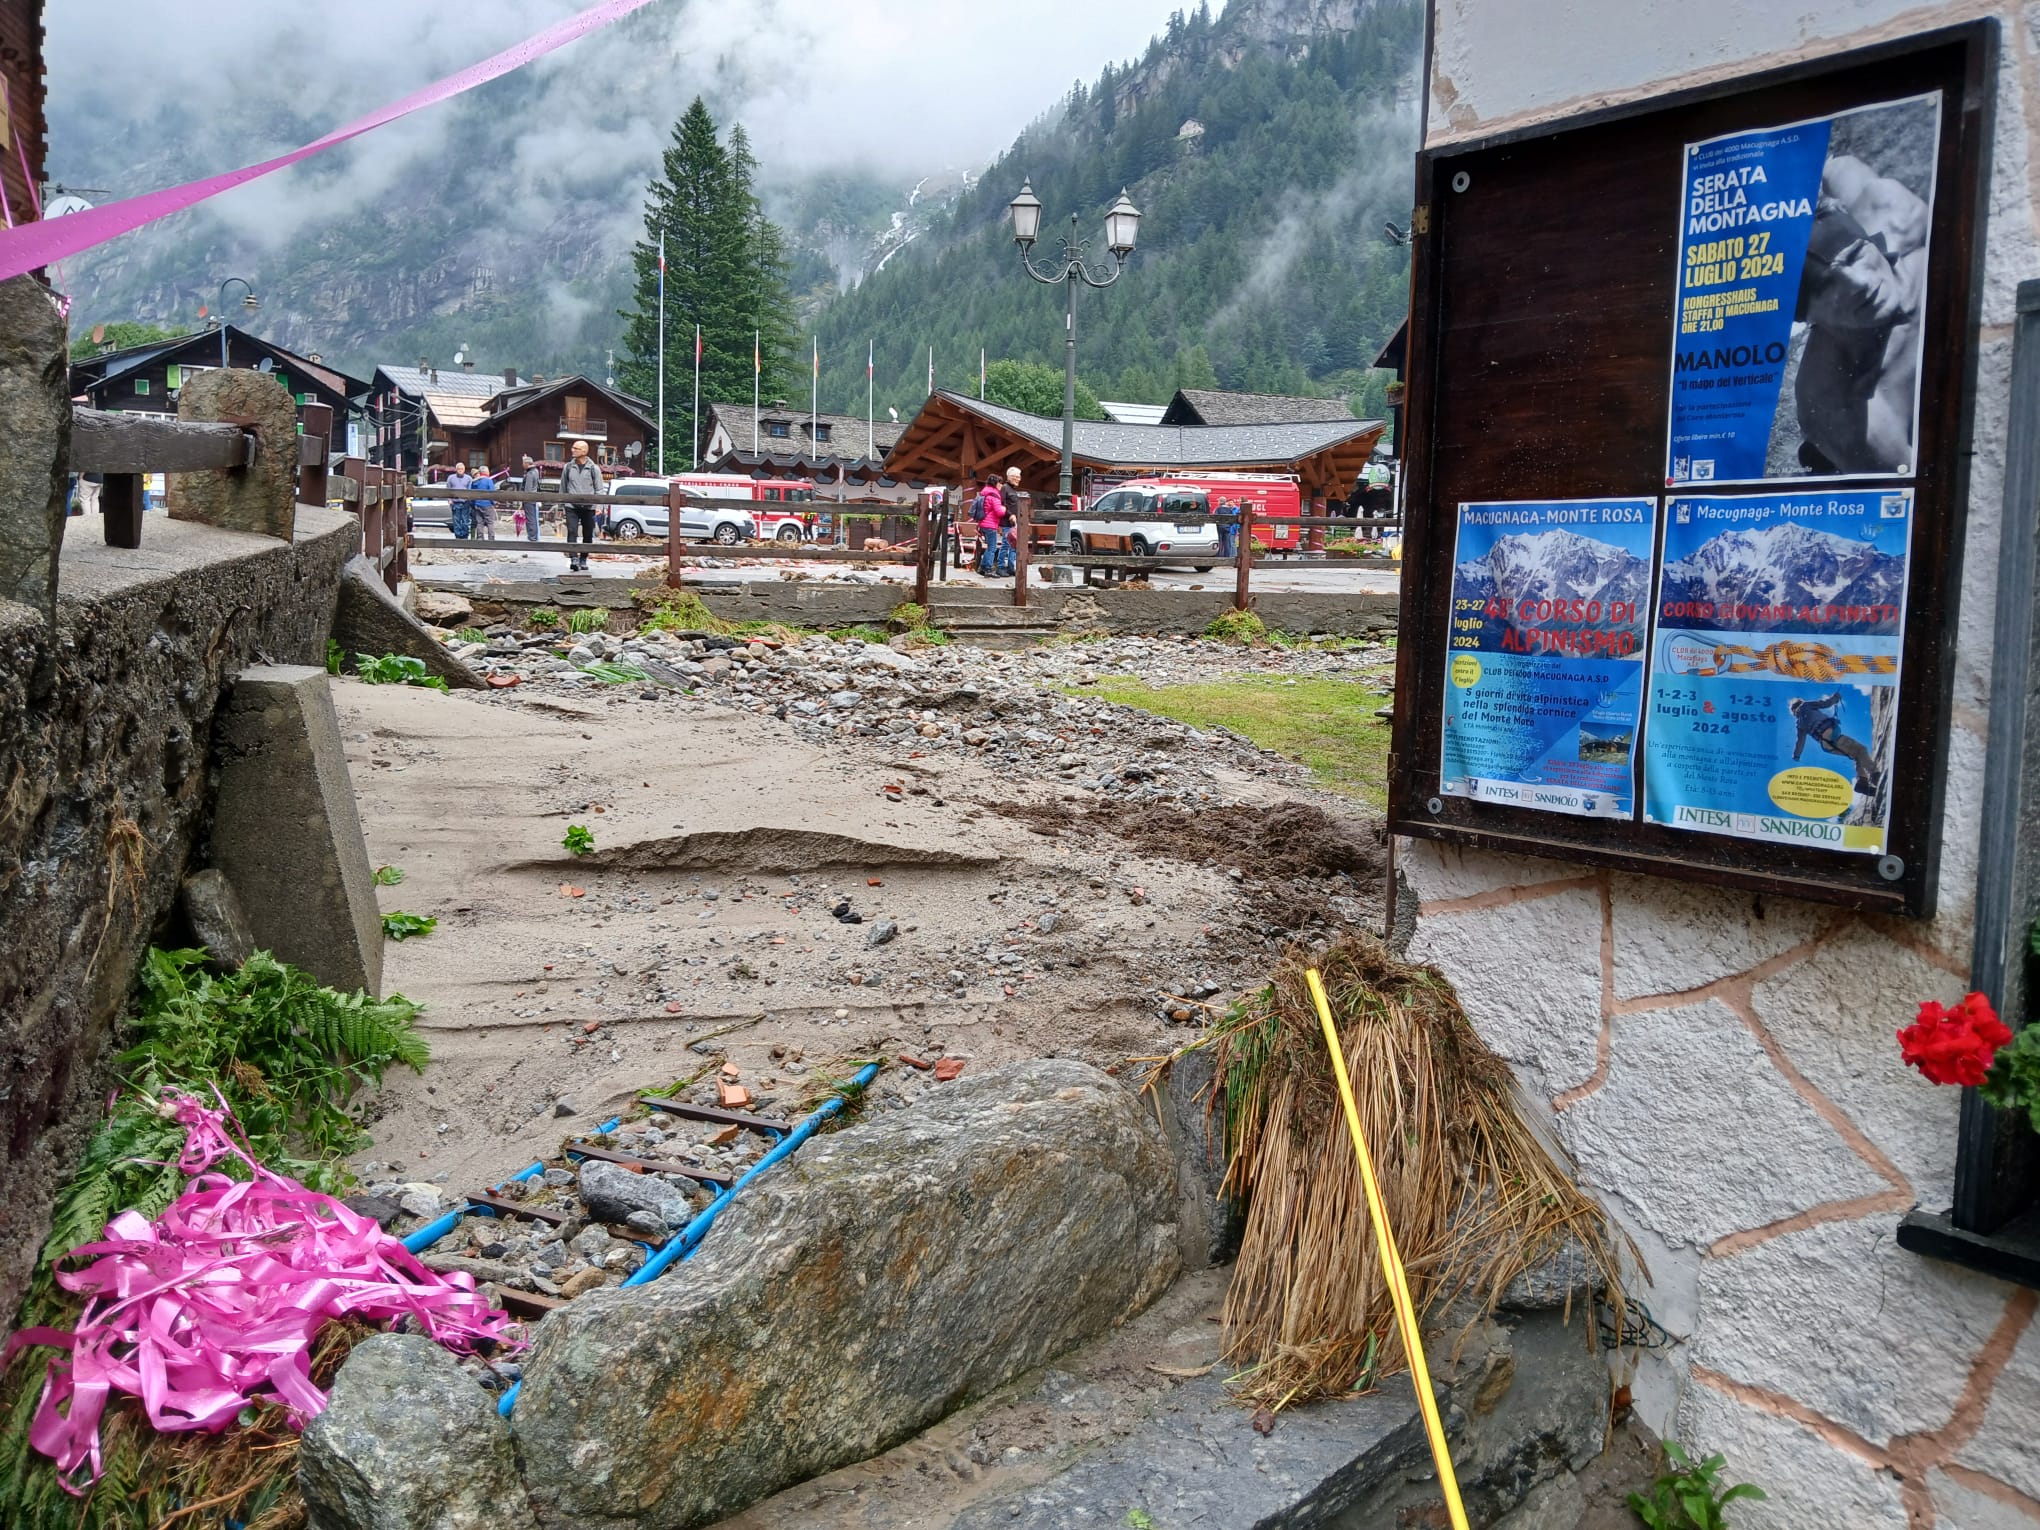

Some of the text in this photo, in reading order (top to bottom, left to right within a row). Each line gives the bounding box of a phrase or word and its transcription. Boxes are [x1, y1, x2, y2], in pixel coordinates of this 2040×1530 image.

[1698, 150, 1714, 160] CLUB
[1741, 140, 1780, 150] Macugnaga
[1692, 165, 1767, 196] SERATA
[1691, 188, 1747, 216] DELLA
[1688, 198, 1813, 235] MONTAGNA
[1686, 232, 1771, 266] SABATO 27
[1685, 252, 1784, 288] LUGLIO 2024
[1683, 288, 1757, 310] KONGRESSHAUS
[1682, 299, 1779, 322] STAFFA DI MACUGNAGA
[1681, 318, 1724, 334] ORE 21,00
[1675, 341, 1786, 373] MANOLO
[1689, 378, 1715, 390] mago
[1717, 376, 1731, 387] del
[1602, 508, 1644, 523] ROSA
[1780, 503, 1823, 518] Monte
[1827, 501, 1865, 516] Rosa
[1519, 599, 1601, 623] CORSO
[1611, 601, 1636, 624] DI
[1663, 601, 1899, 623] CORSO GIOVANI ALPINISTI
[1454, 617, 1483, 630] luglio
[1453, 637, 1481, 648] 2024
[1501, 627, 1635, 655] ALPINISMO
[1483, 667, 1502, 676] CLUB
[1533, 671, 1585, 683] MACUGNAGA
[1465, 688, 1589, 707] 5 giorni di vita alpinistica
[1657, 689, 1697, 701] 1-2-3
[1730, 694, 1772, 707] 1-2-3
[1463, 700, 1489, 710] nella
[1493, 701, 1535, 715] splendida
[1537, 706, 1577, 719] cornice
[1657, 703, 1698, 717] luglio
[1703, 700, 1715, 714] &
[1461, 710, 1535, 727] del Monte Moro
[1722, 711, 1776, 723] agosto
[1692, 722, 1730, 734] 2024
[1662, 750, 1676, 759] alla
[1485, 785, 1519, 799] INTESA
[1680, 807, 1842, 842] INTESA SANPAOLO
